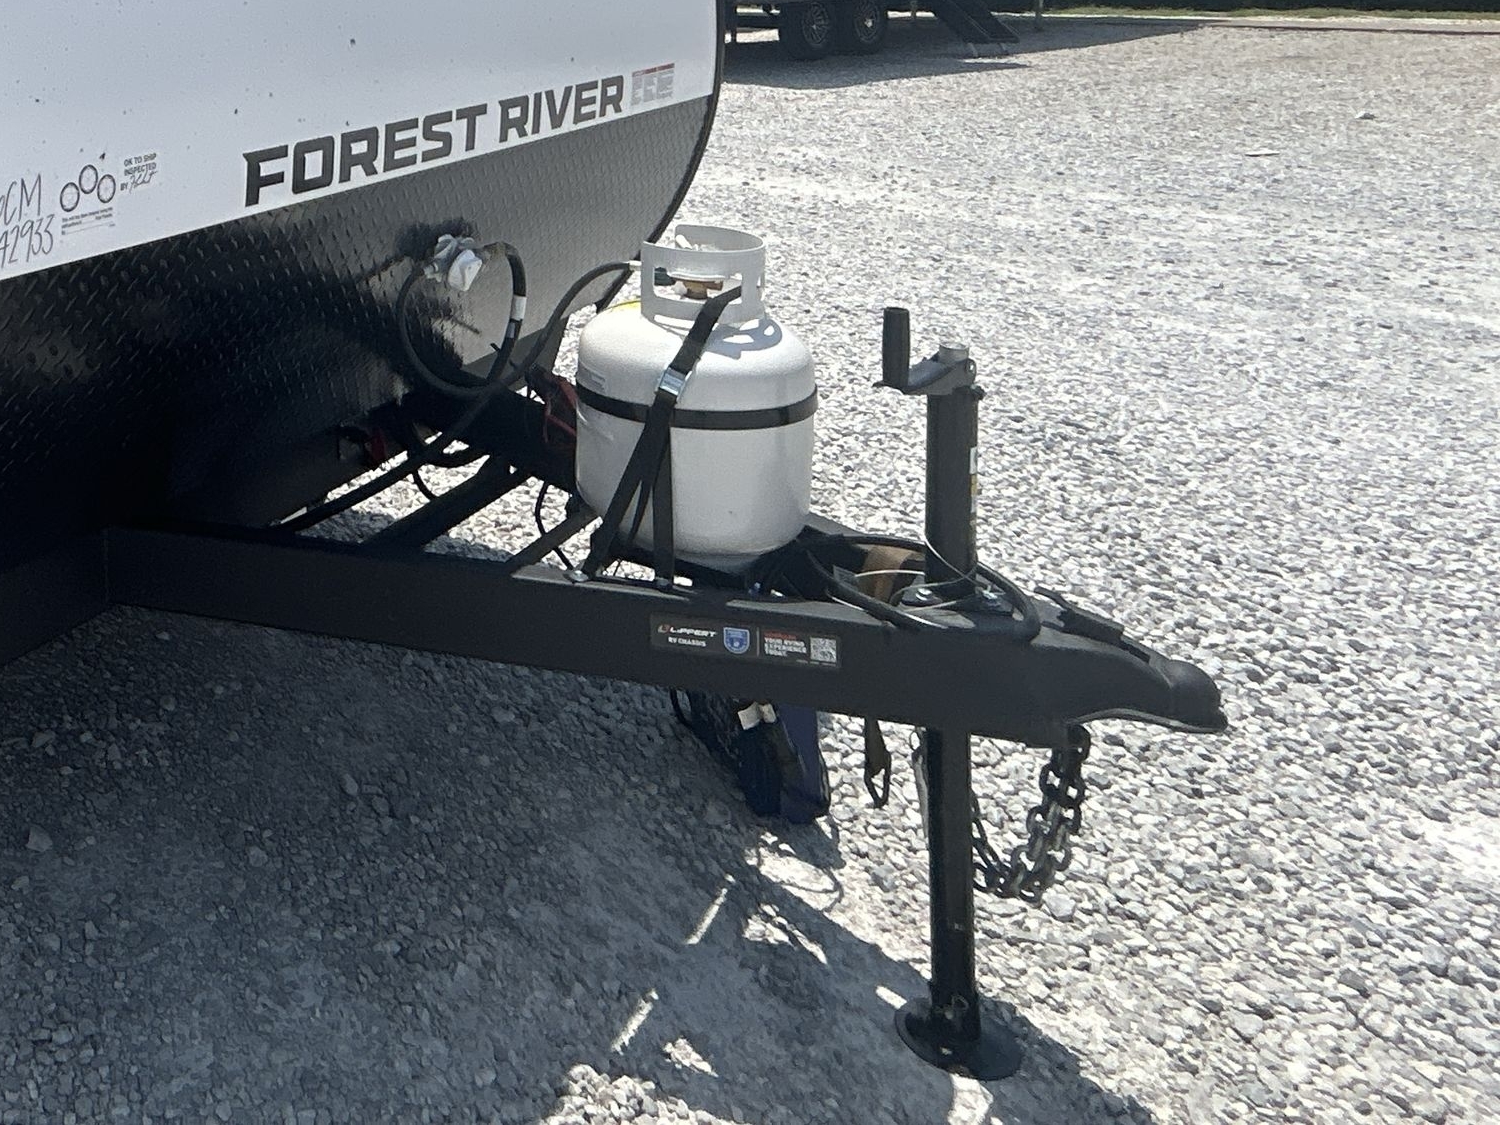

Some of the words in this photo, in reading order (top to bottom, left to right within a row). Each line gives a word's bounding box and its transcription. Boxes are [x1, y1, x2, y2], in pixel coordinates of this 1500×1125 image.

[243, 103, 488, 208] FOREST
[498, 75, 625, 144] RIVER
[124, 158, 133, 167] OK
[134, 156, 143, 164] TO
[143, 152, 157, 162] SHIP
[124, 162, 157, 176] INSPECTED
[120, 181, 128, 191] BY
